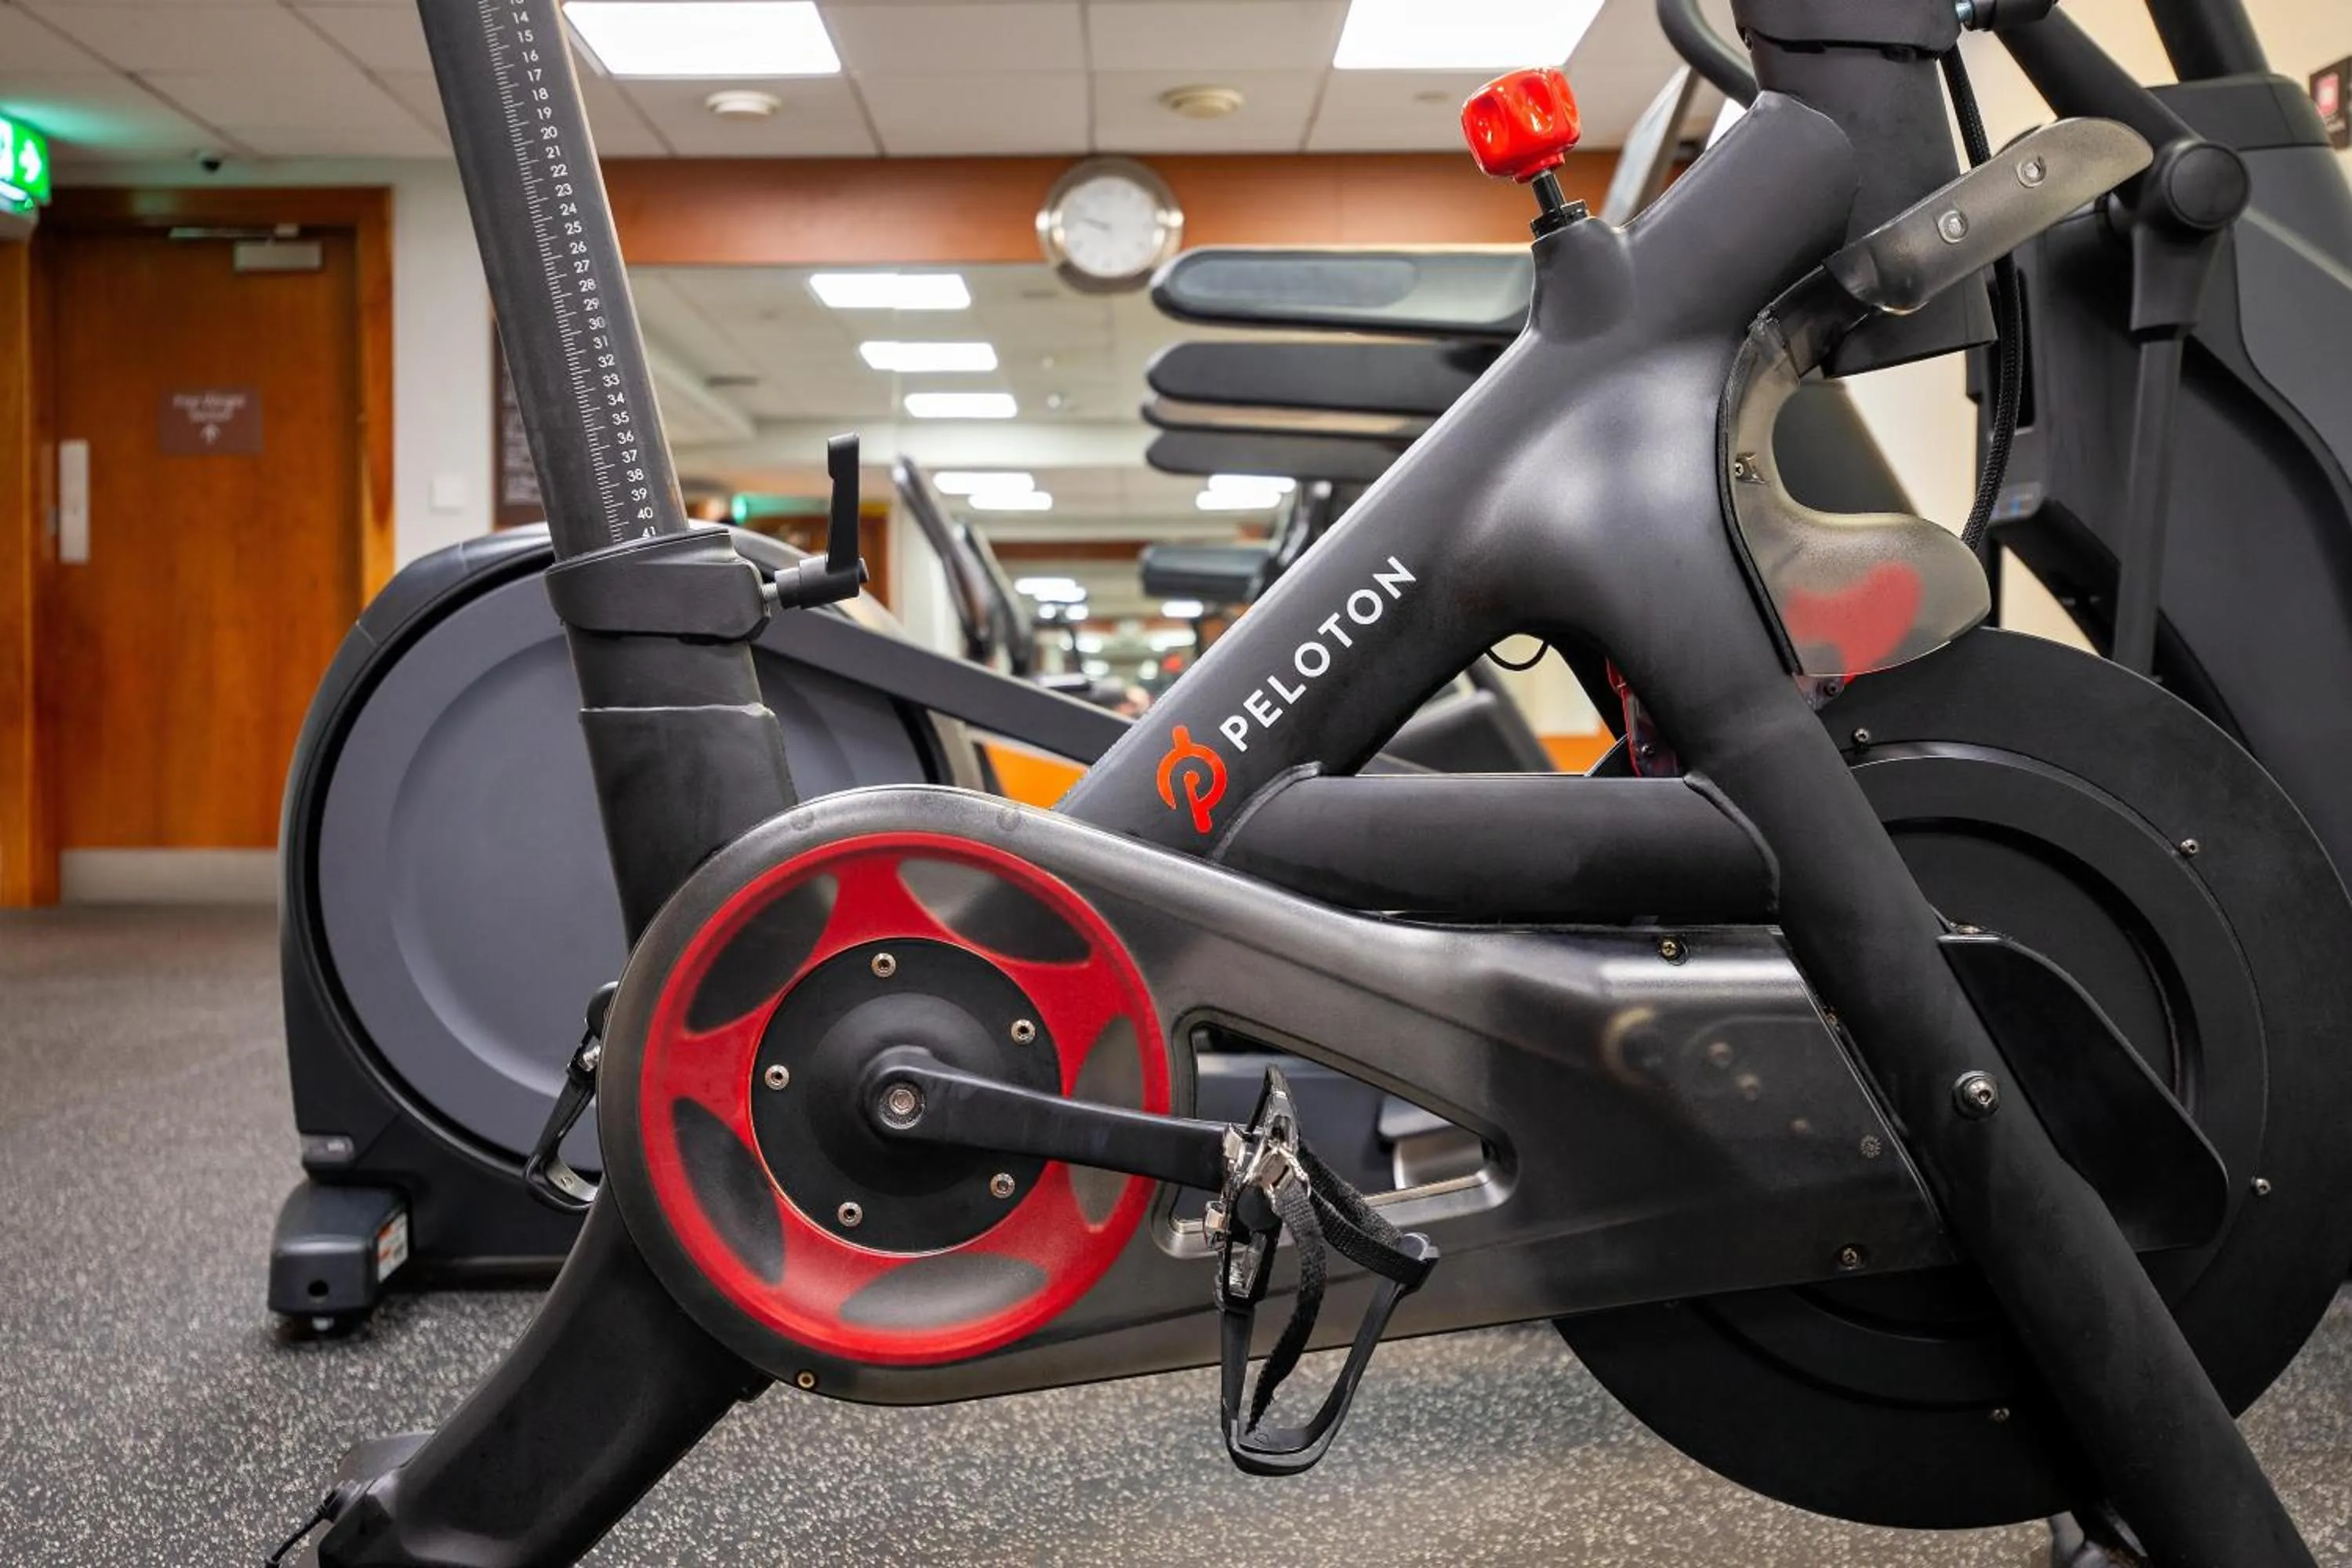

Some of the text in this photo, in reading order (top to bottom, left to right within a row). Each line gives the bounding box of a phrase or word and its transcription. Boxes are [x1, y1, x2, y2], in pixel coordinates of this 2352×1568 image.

[512, 10, 529, 24] 14
[517, 29, 534, 43] 15
[521, 49, 539, 64] 16
[527, 68, 543, 82] 17
[531, 87, 550, 101] 18
[536, 106, 553, 121] 19
[539, 125, 558, 140] 20
[545, 144, 561, 159] 21
[550, 162, 568, 178] 22
[554, 183, 573, 198] 23
[558, 201, 578, 216] 24
[564, 220, 583, 236] 25
[568, 240, 587, 255] 26
[573, 259, 590, 274] 27
[578, 278, 597, 292] 28
[583, 297, 600, 311] 29
[587, 316, 606, 331] 30
[592, 335, 608, 350] 31
[597, 354, 615, 368] 32
[601, 372, 621, 389] 33
[606, 391, 625, 407] 34
[611, 410, 630, 426] 35
[616, 429, 635, 445] 36
[620, 448, 638, 464] 37
[626, 467, 645, 483] 38
[630, 487, 648, 503] 39
[637, 506, 654, 520] 40
[1219, 555, 1417, 753] PELOTON
